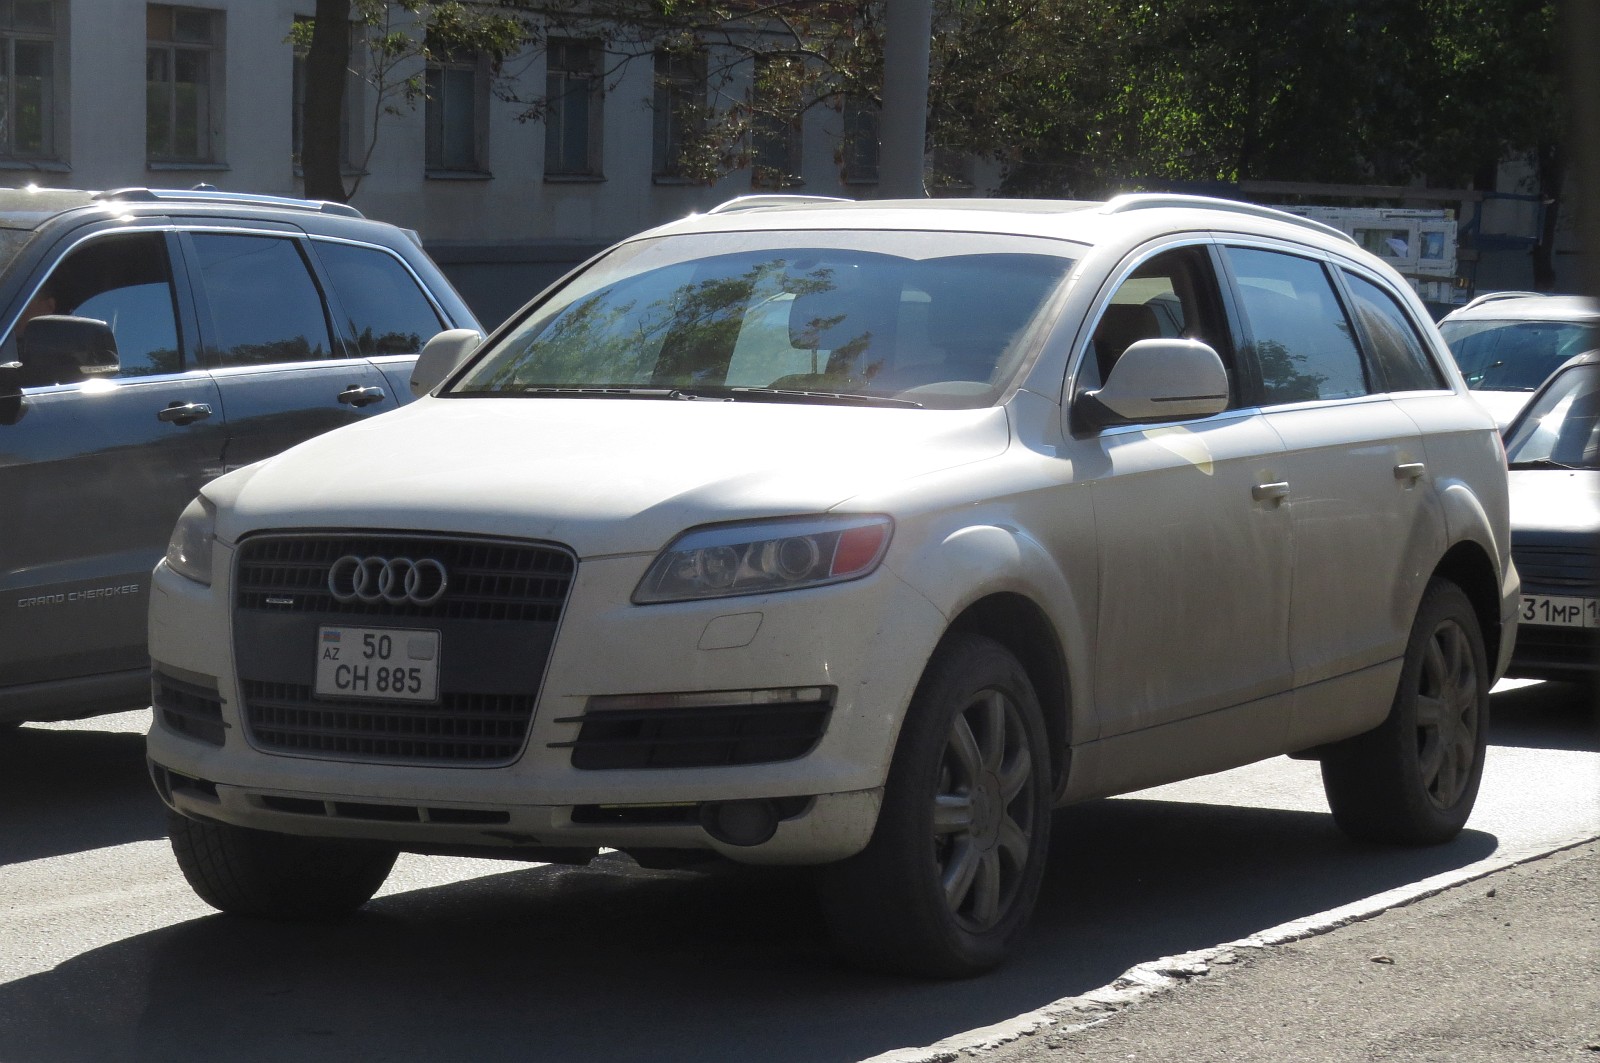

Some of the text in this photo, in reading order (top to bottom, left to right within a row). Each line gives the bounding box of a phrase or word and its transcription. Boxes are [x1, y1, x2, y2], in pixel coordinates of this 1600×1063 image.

[18, 584, 140, 607] GRAND CHEROKEE
[323, 647, 340, 660] AZ
[362, 633, 392, 660] 50
[335, 664, 422, 693] CH 885
